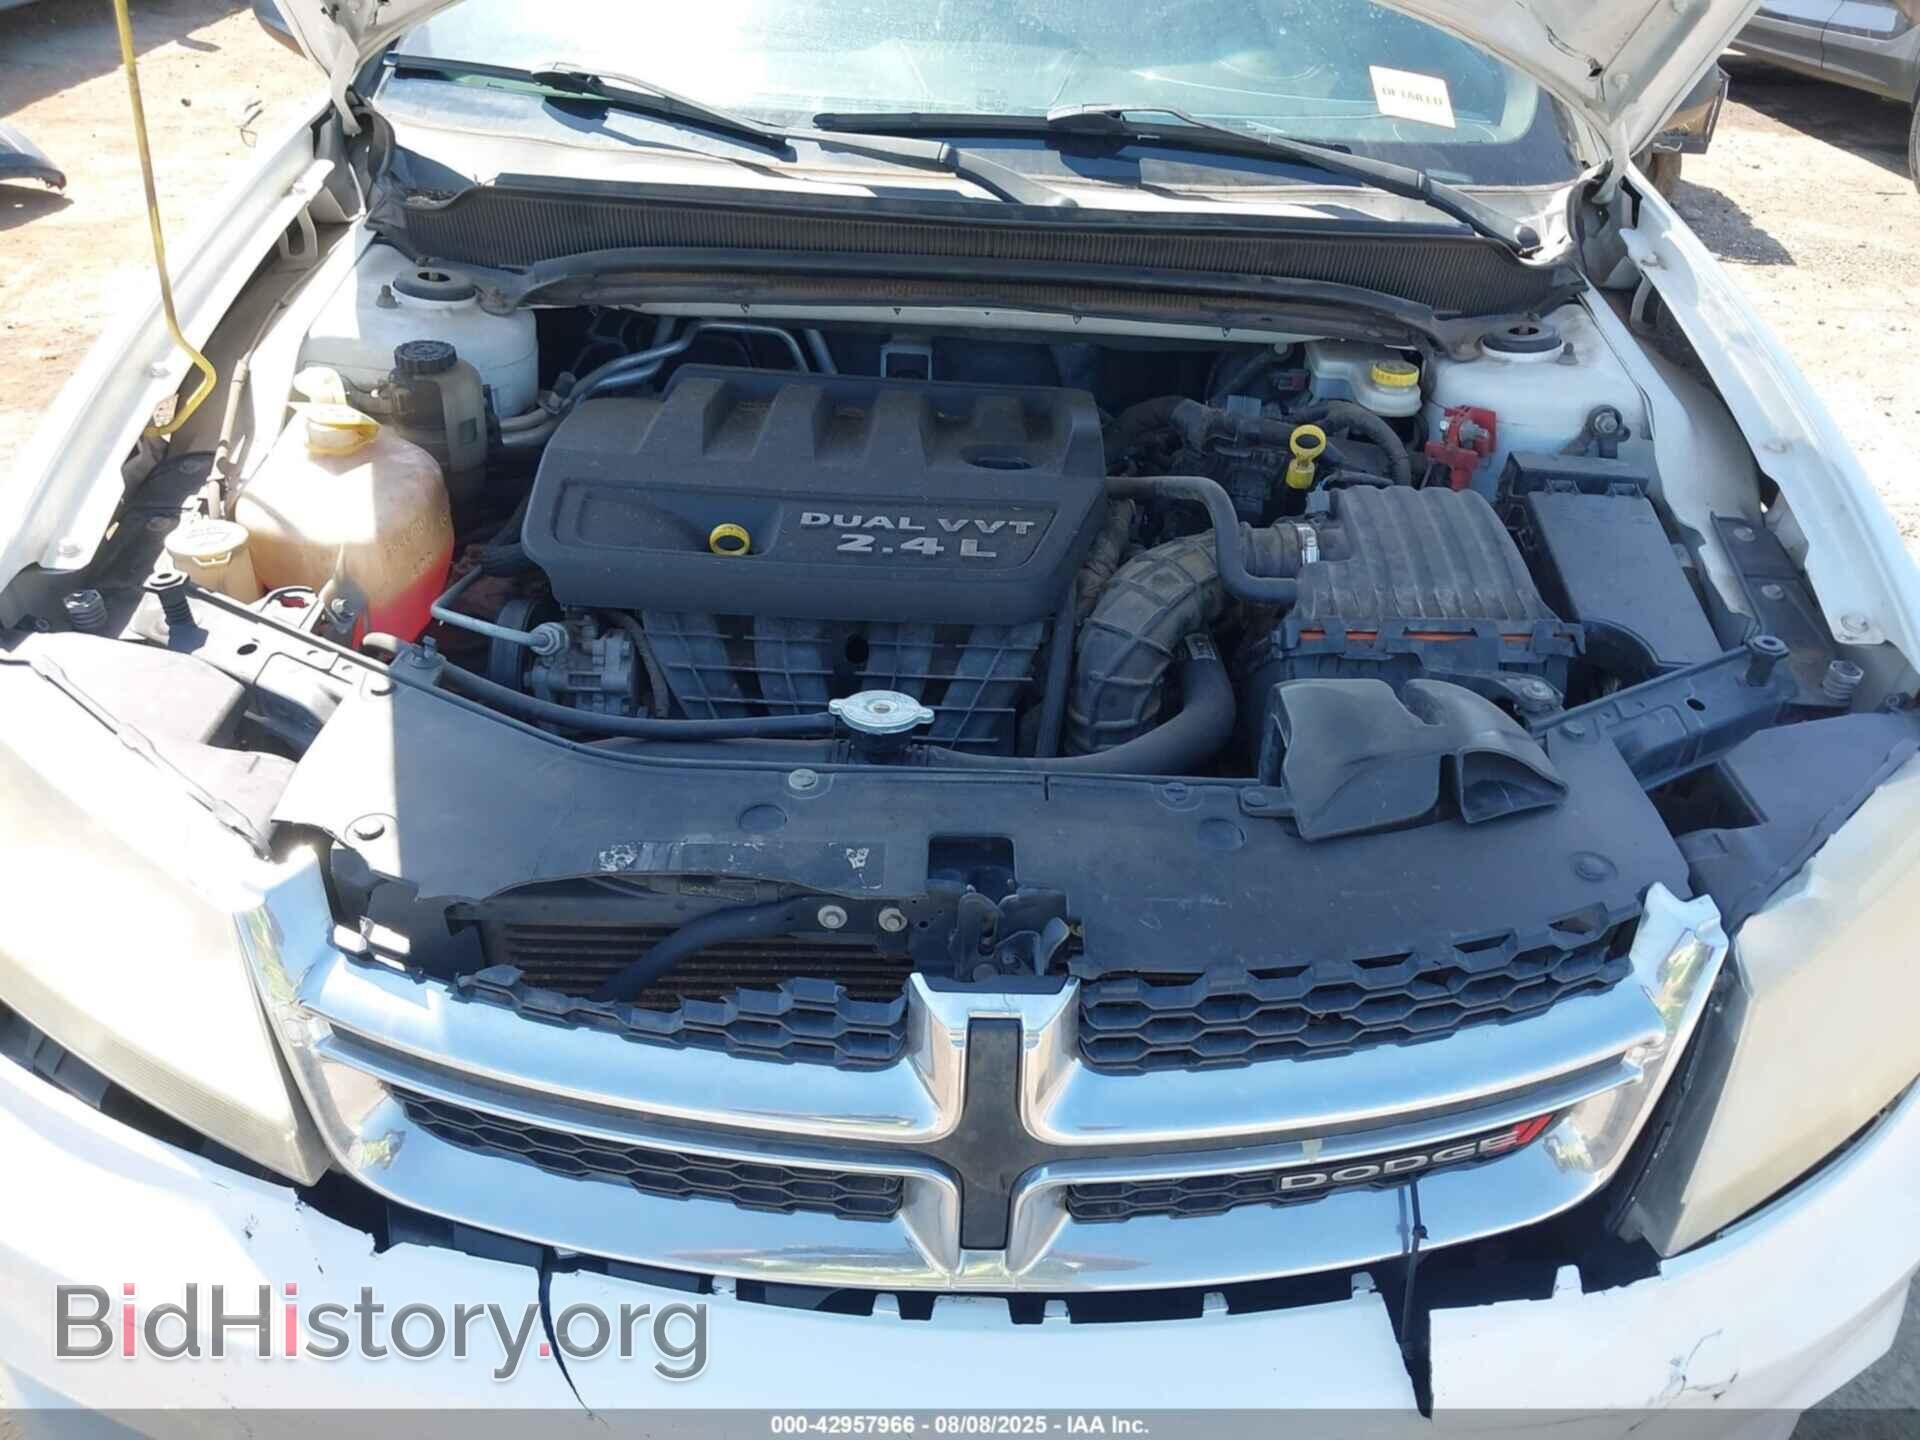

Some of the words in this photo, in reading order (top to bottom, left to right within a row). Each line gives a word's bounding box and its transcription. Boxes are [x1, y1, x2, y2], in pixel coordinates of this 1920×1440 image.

[800, 511, 926, 531] DUAL
[937, 518, 1036, 536] VVT
[1279, 1130, 1518, 1190] DODGE
